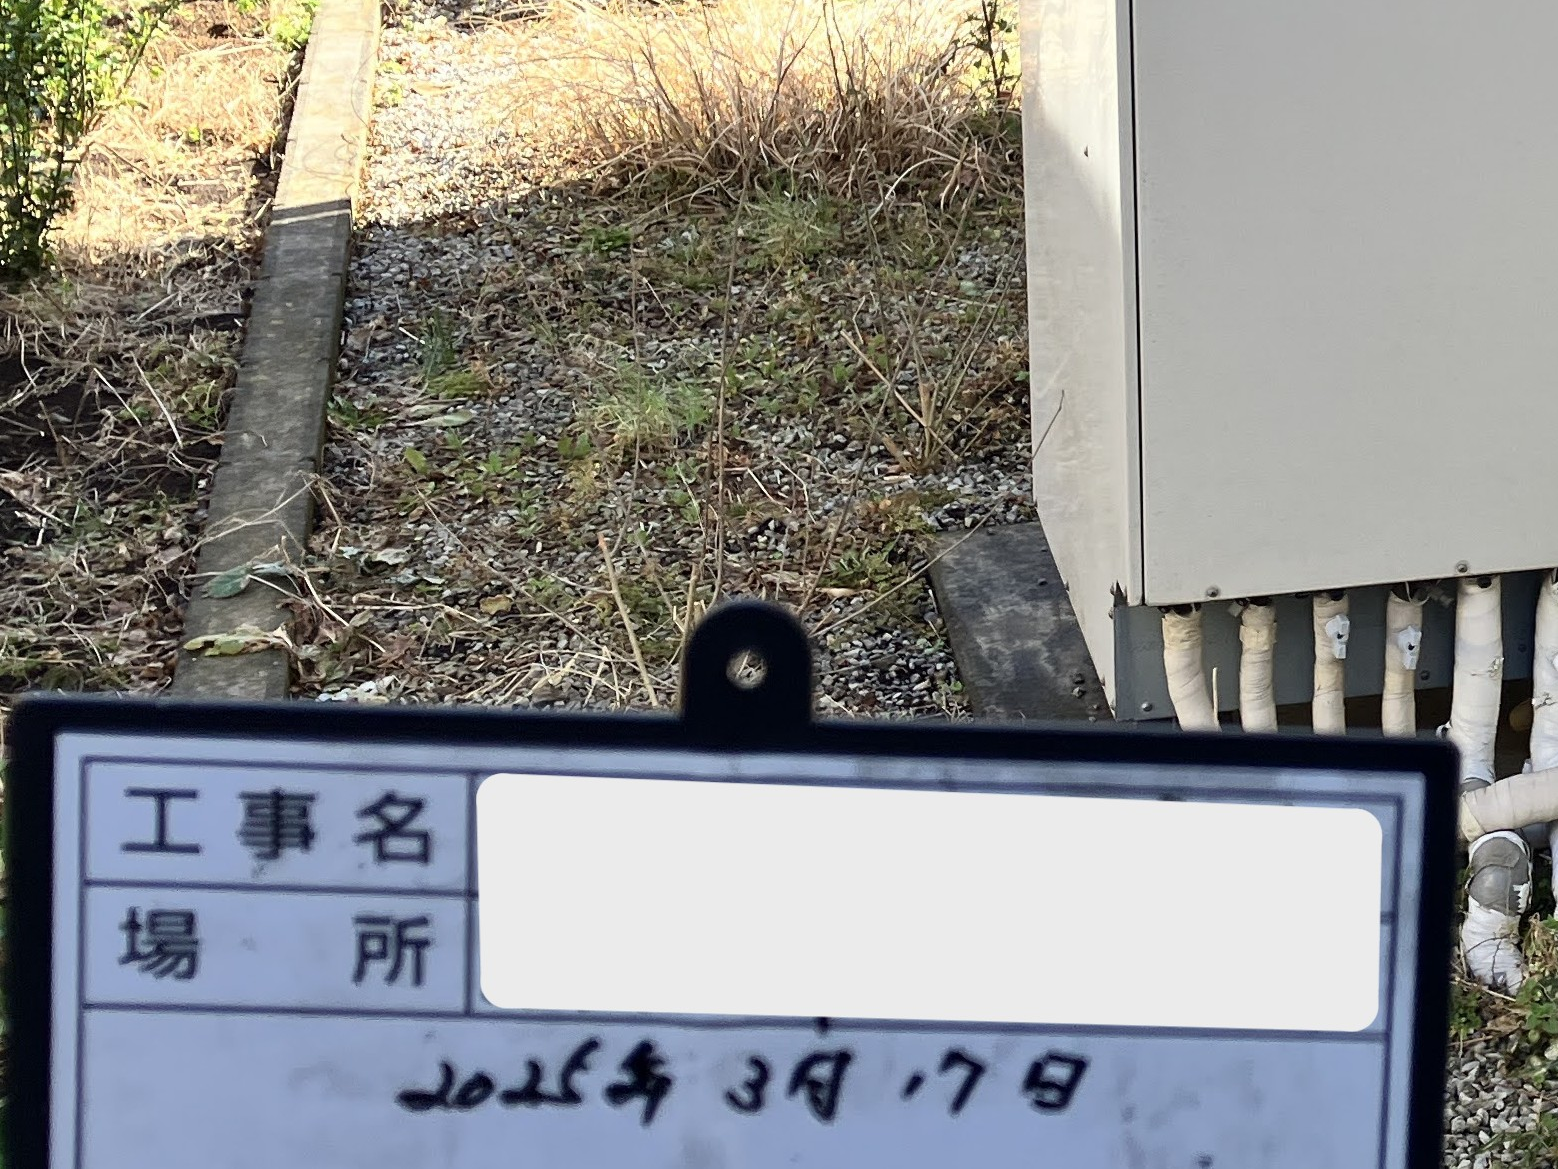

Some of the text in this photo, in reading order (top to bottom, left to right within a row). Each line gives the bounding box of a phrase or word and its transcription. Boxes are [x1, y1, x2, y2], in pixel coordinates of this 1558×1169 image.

[120, 787, 432, 865] 工事名
[118, 906, 431, 987] 場所
